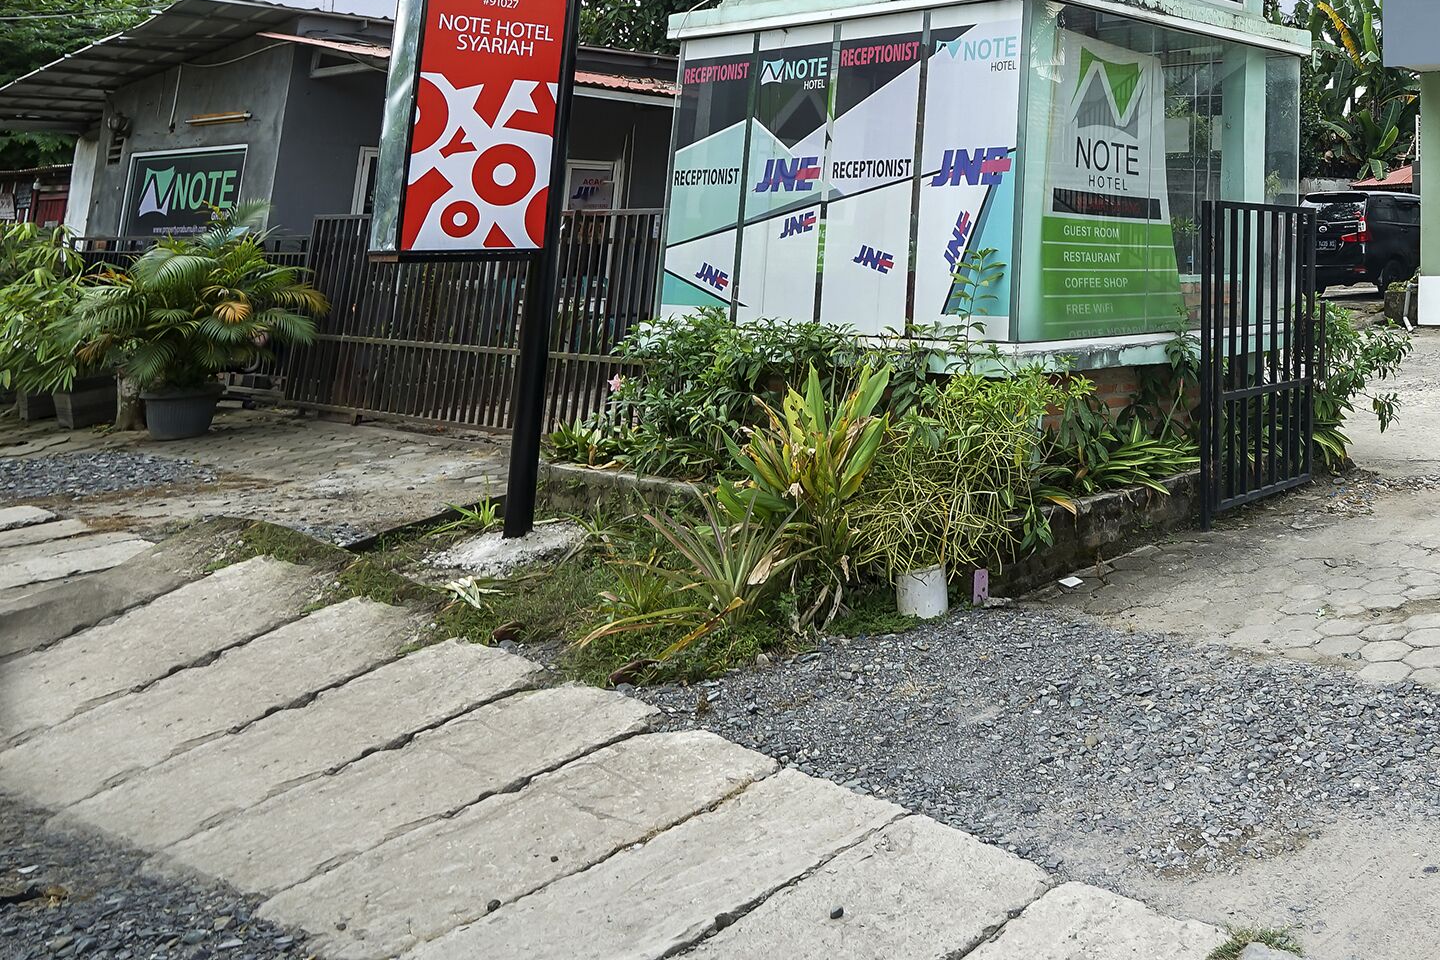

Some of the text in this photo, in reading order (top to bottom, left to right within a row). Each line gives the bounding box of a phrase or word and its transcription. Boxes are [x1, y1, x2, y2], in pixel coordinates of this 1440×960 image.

[439, 13, 554, 41] NOTE HOTEL
[456, 34, 534, 57] SYARIAH
[840, 41, 920, 67] RECEPTIONIST
[963, 36, 1017, 61] NOTE
[684, 62, 750, 84] RECEPTIONIST
[784, 57, 829, 81] NOTE
[990, 60, 1016, 72] HOTEL
[803, 79, 825, 90] HOTEL
[927, 146, 1012, 187] JNE
[1075, 136, 1139, 176] NOTE
[674, 168, 740, 186] RECEPTIONIST
[752, 156, 822, 193] JNE
[832, 159, 911, 179] RECEPTIONIST
[172, 170, 237, 210] NOTE
[1088, 174, 1128, 191] HOTEL
[778, 210, 817, 239] JNE
[1063, 224, 1120, 238] GUEST ROOM
[944, 210, 972, 273] JNE
[851, 244, 895, 274] JNE
[1063, 251, 1121, 263] RESTAURANT
[694, 262, 729, 292] JNE
[1064, 277, 1129, 289] COFFEE SHOP
[1066, 303, 1091, 315] FREE
